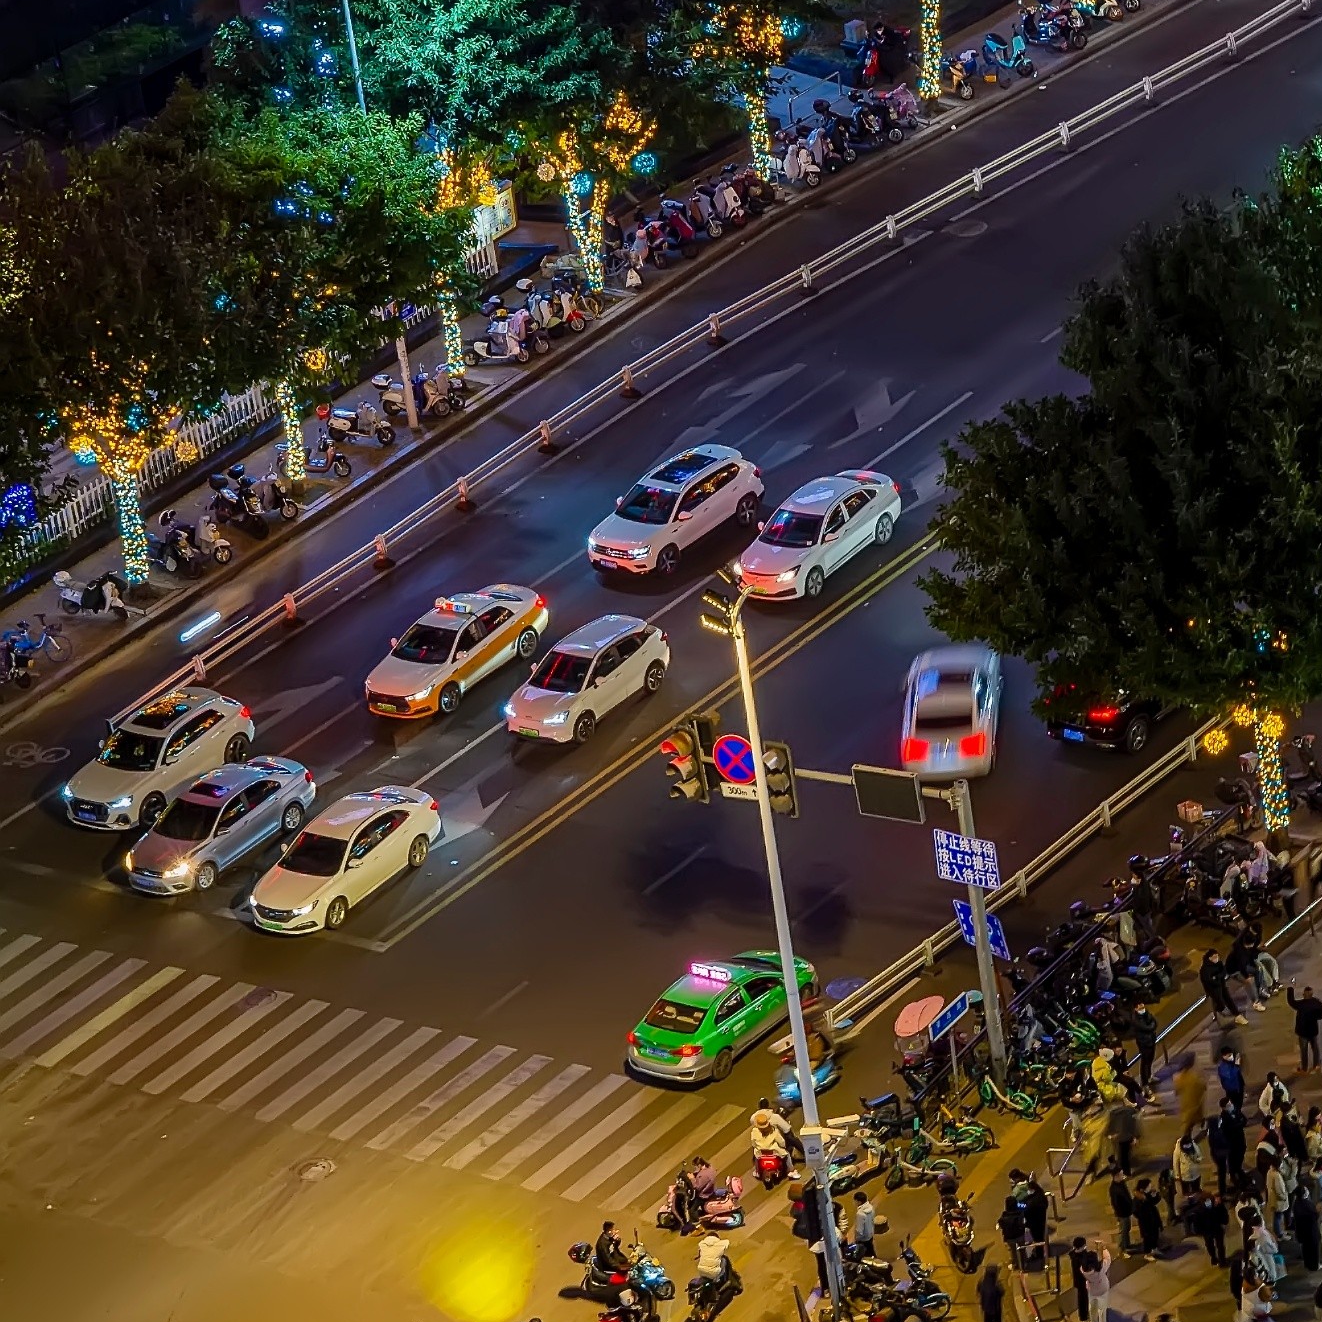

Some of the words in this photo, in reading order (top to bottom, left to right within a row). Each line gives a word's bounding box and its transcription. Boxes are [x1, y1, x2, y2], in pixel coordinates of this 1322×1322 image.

[937, 830, 994, 858] 停止线等待
[938, 847, 996, 872] 按LED提示
[940, 863, 999, 888] 进入待行区
